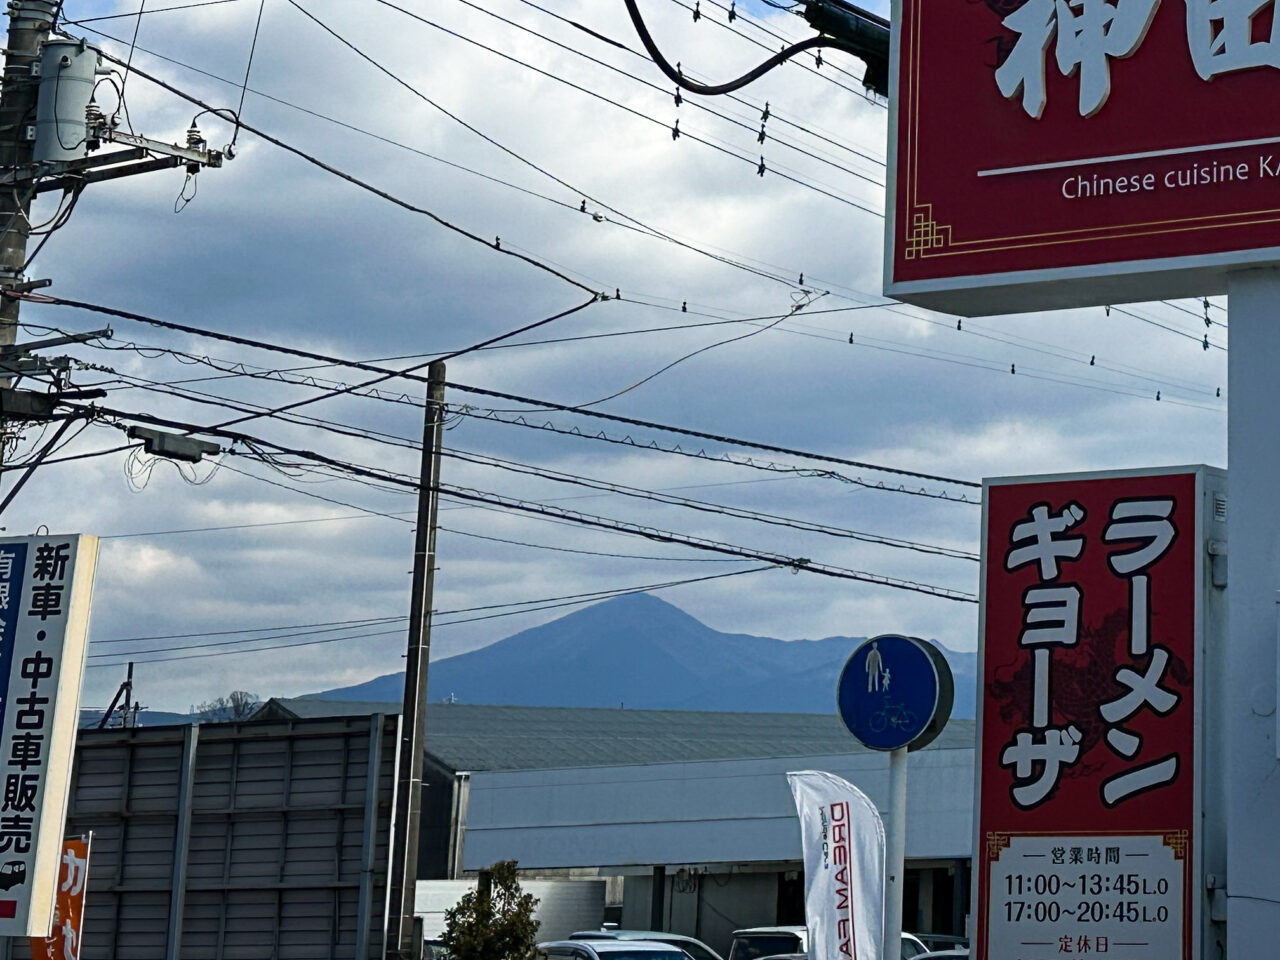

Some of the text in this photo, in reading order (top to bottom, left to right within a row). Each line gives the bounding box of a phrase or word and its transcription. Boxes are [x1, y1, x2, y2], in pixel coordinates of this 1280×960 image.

[1061, 168, 1156, 200] Chinese
[1163, 160, 1250, 190] cuisine
[0, 542, 70, 854] 新車・中古車販売
[1004, 503, 1085, 809] ギョーザ
[1100, 498, 1180, 806] ラーメン
[1051, 847, 1121, 864] 営業時間
[1058, 935, 1109, 953] 定休日
